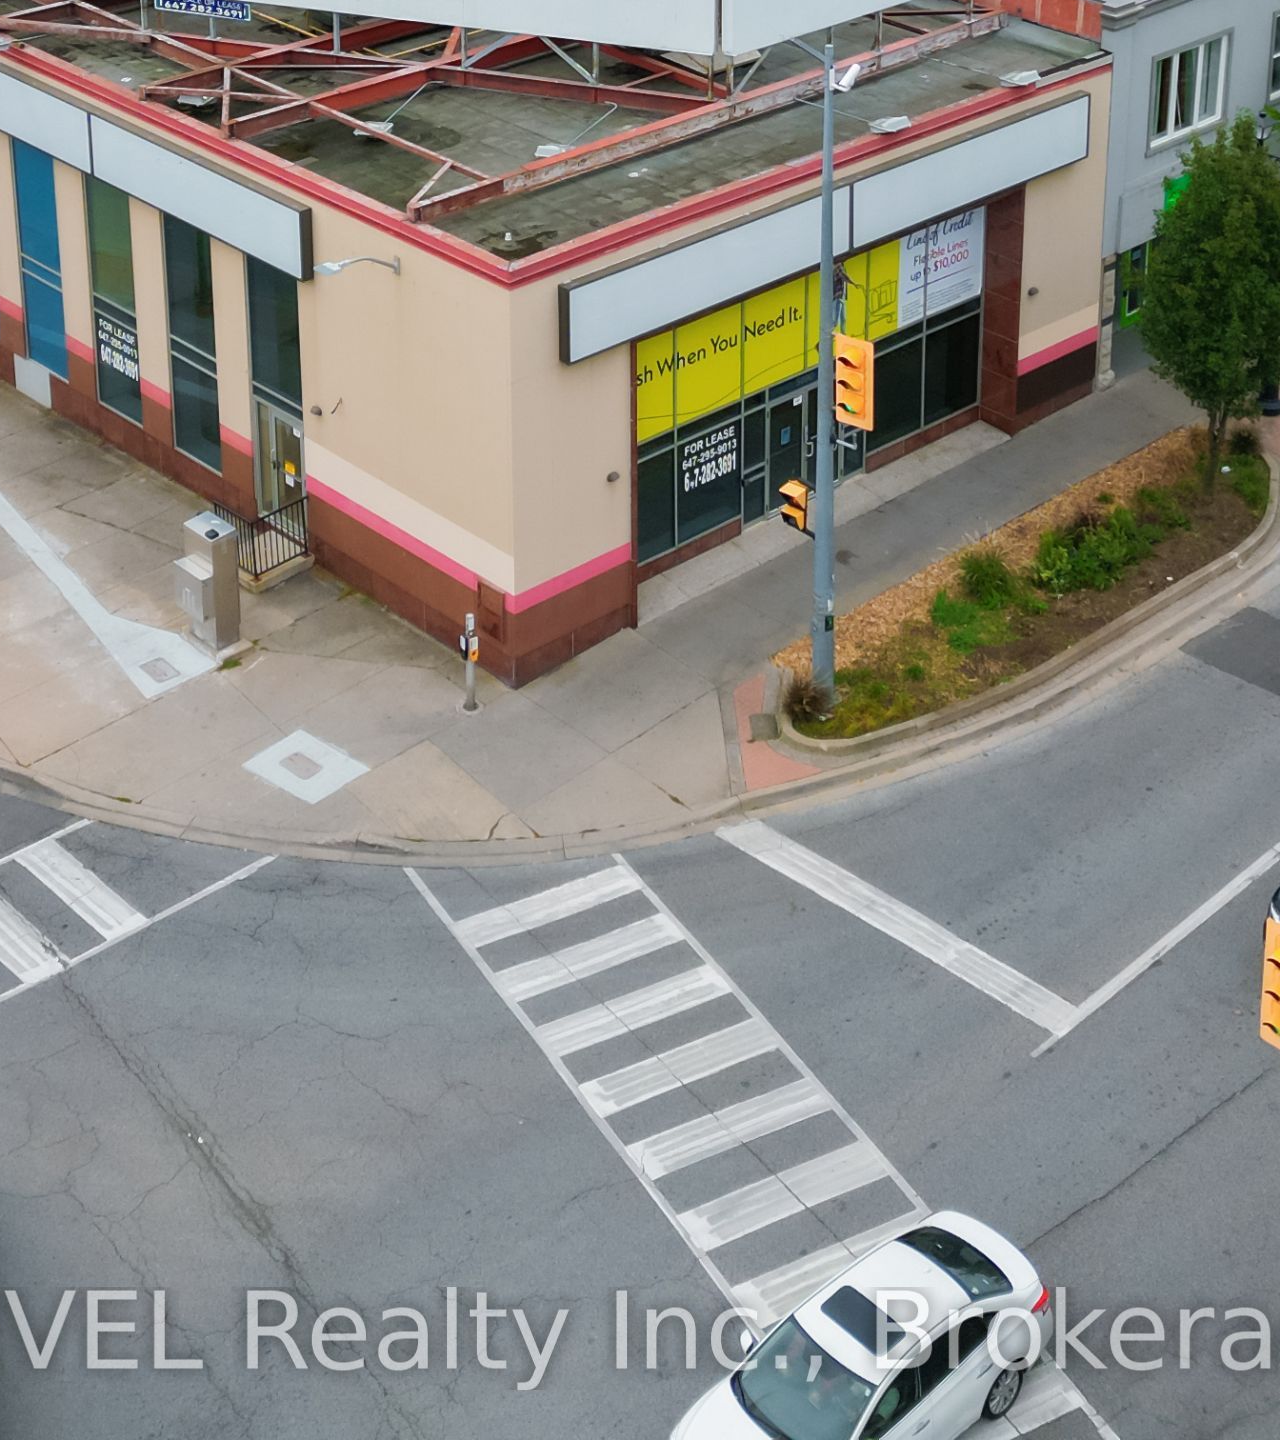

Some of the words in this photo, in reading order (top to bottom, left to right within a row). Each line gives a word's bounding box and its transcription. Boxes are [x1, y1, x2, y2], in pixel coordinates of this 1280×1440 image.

[164, 0, 186, 10] 647
[189, 3, 212, 13] 282
[216, 7, 242, 18] 3691
[217, 0, 242, 10] LEASE
[947, 239, 969, 252] Lines
[910, 271, 922, 282] up
[933, 249, 969, 272] $10,000
[656, 347, 707, 377] When
[710, 334, 738, 355] You
[743, 307, 785, 342] Need
[788, 306, 803, 323] It.
[682, 438, 737, 471] 647-295-9013
[684, 440, 704, 457] FOR
[705, 425, 735, 447] LEASE
